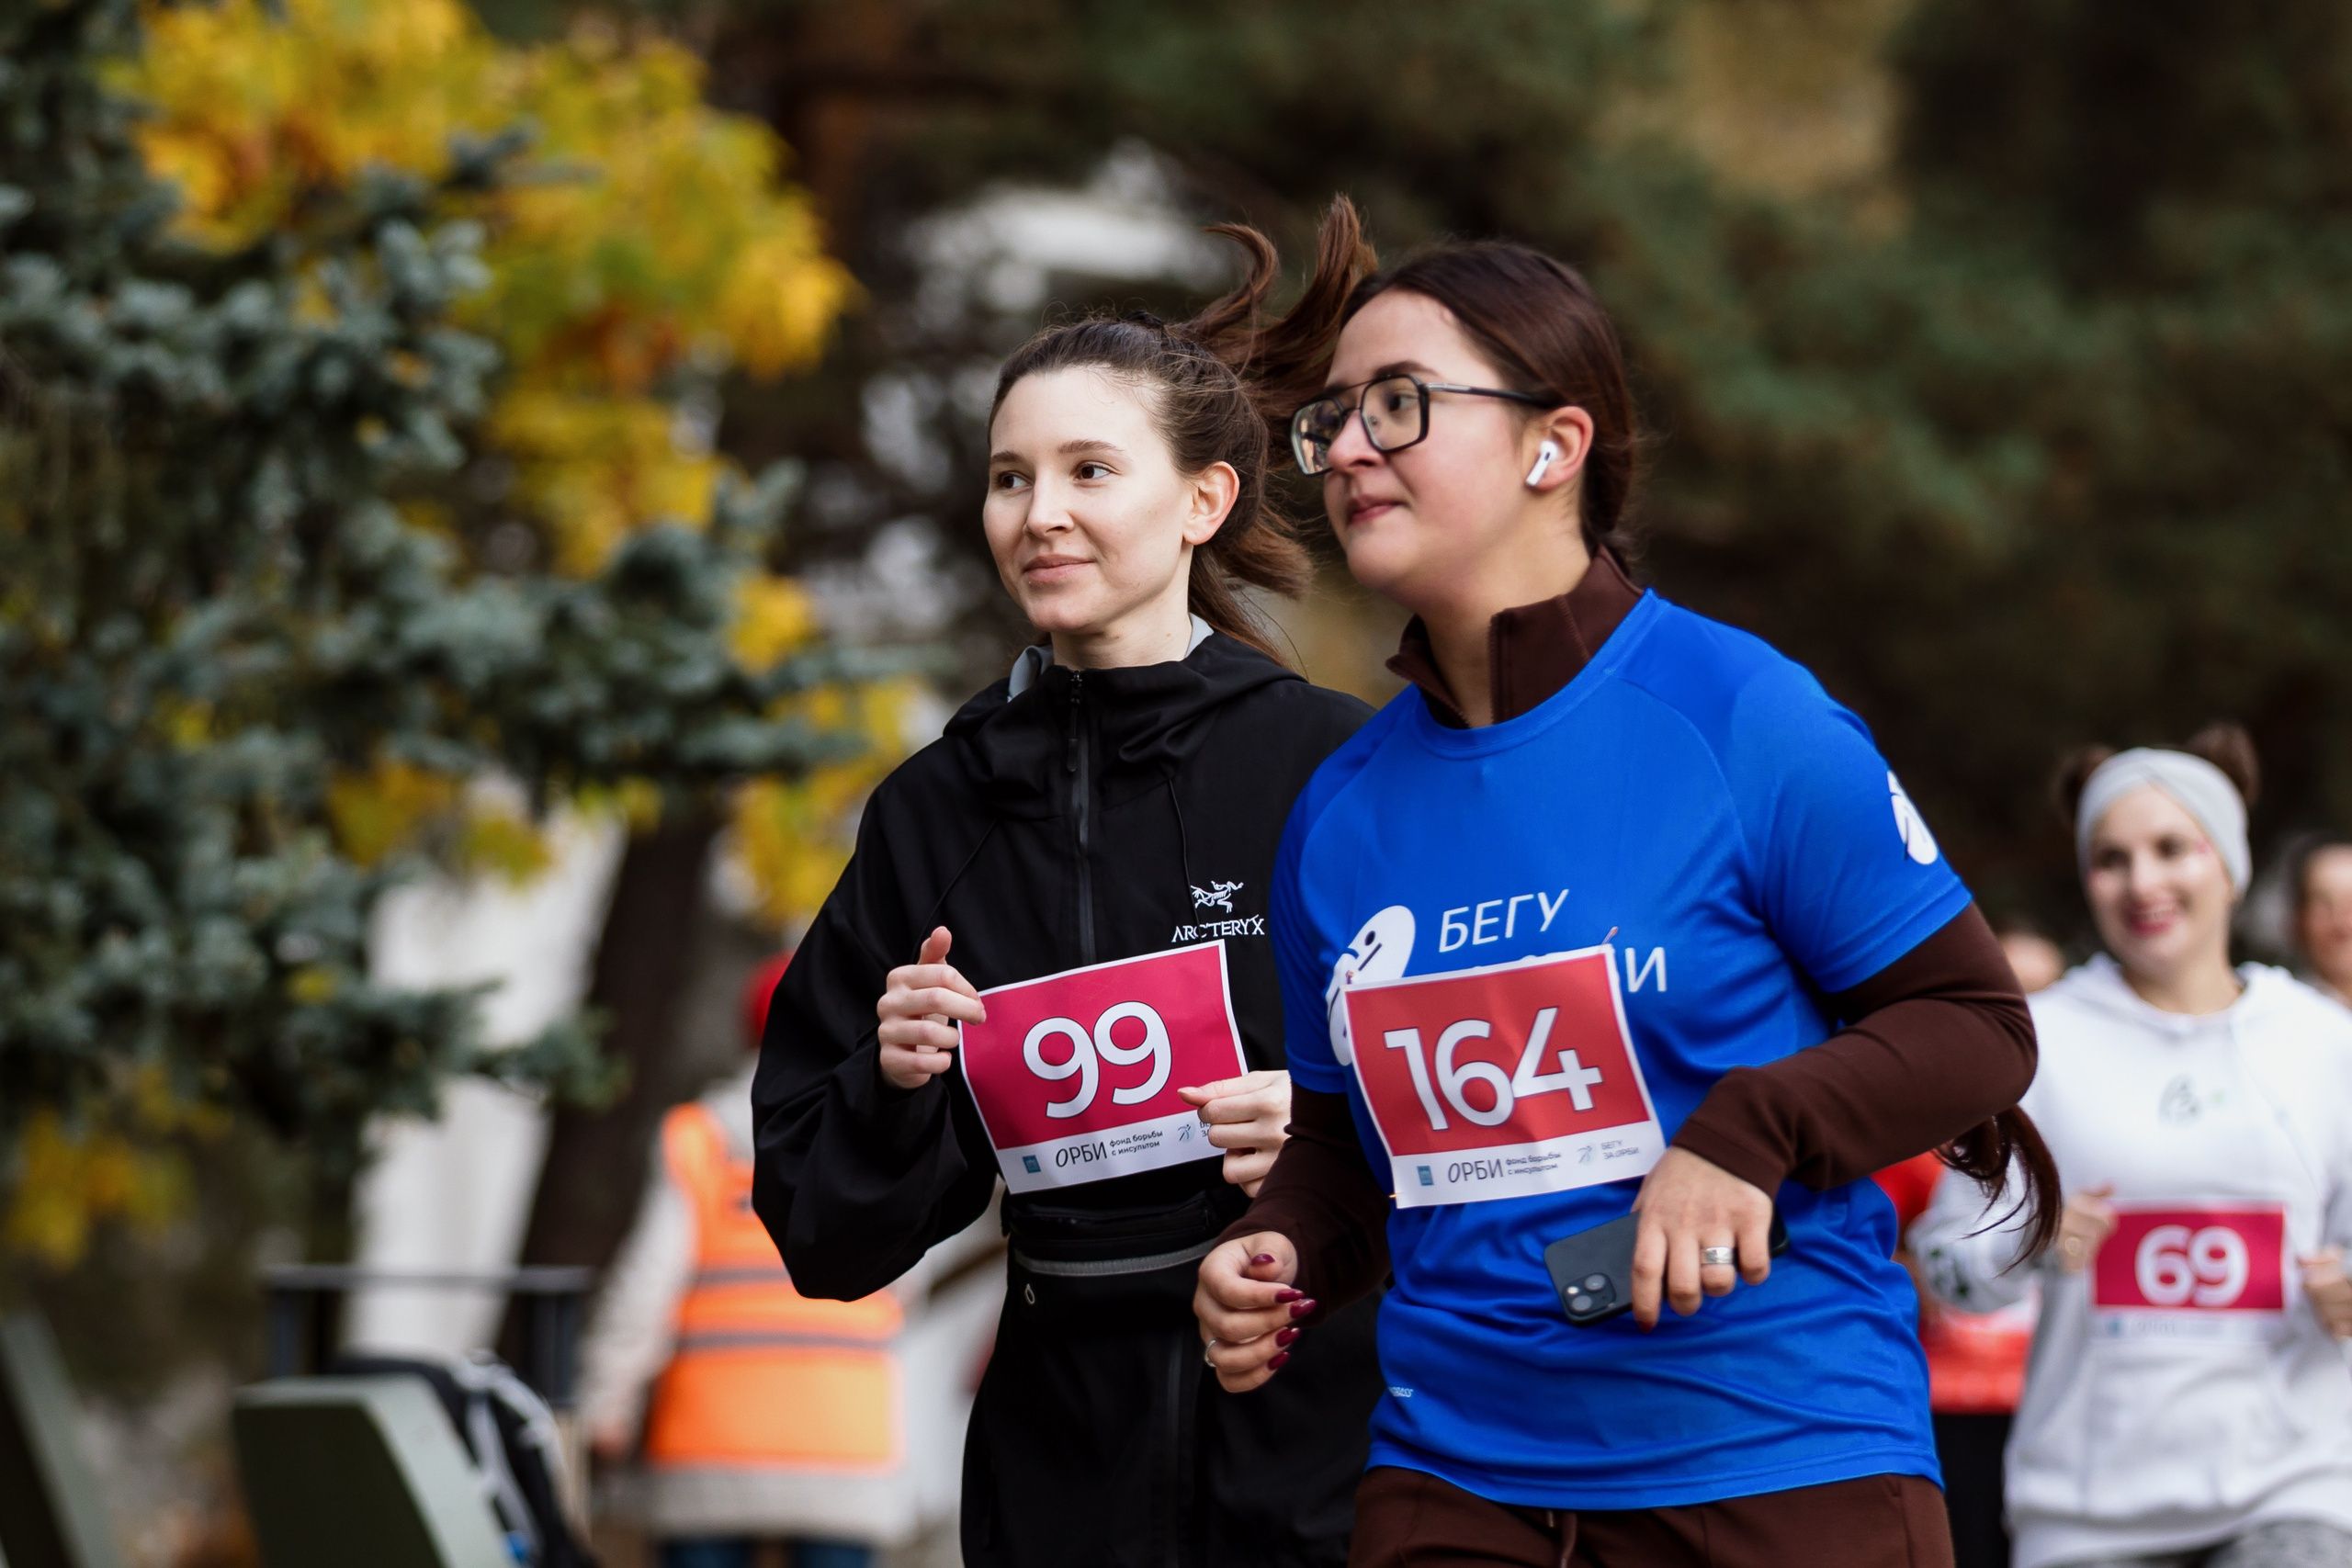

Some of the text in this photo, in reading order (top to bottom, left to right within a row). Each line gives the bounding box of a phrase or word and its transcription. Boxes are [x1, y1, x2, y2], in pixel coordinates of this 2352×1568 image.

[1439, 888, 1569, 953] БЕГУ
[1022, 1000, 1172, 1120] 99
[1383, 1006, 1604, 1132] 164
[1055, 1141, 1108, 1168] ОРБИ
[1109, 1130, 1163, 1148] фонд борьбы
[1118, 1141, 1160, 1155] инсультом
[1447, 1158, 1505, 1184] ОРБИ
[2134, 1224, 2250, 1308] 69
